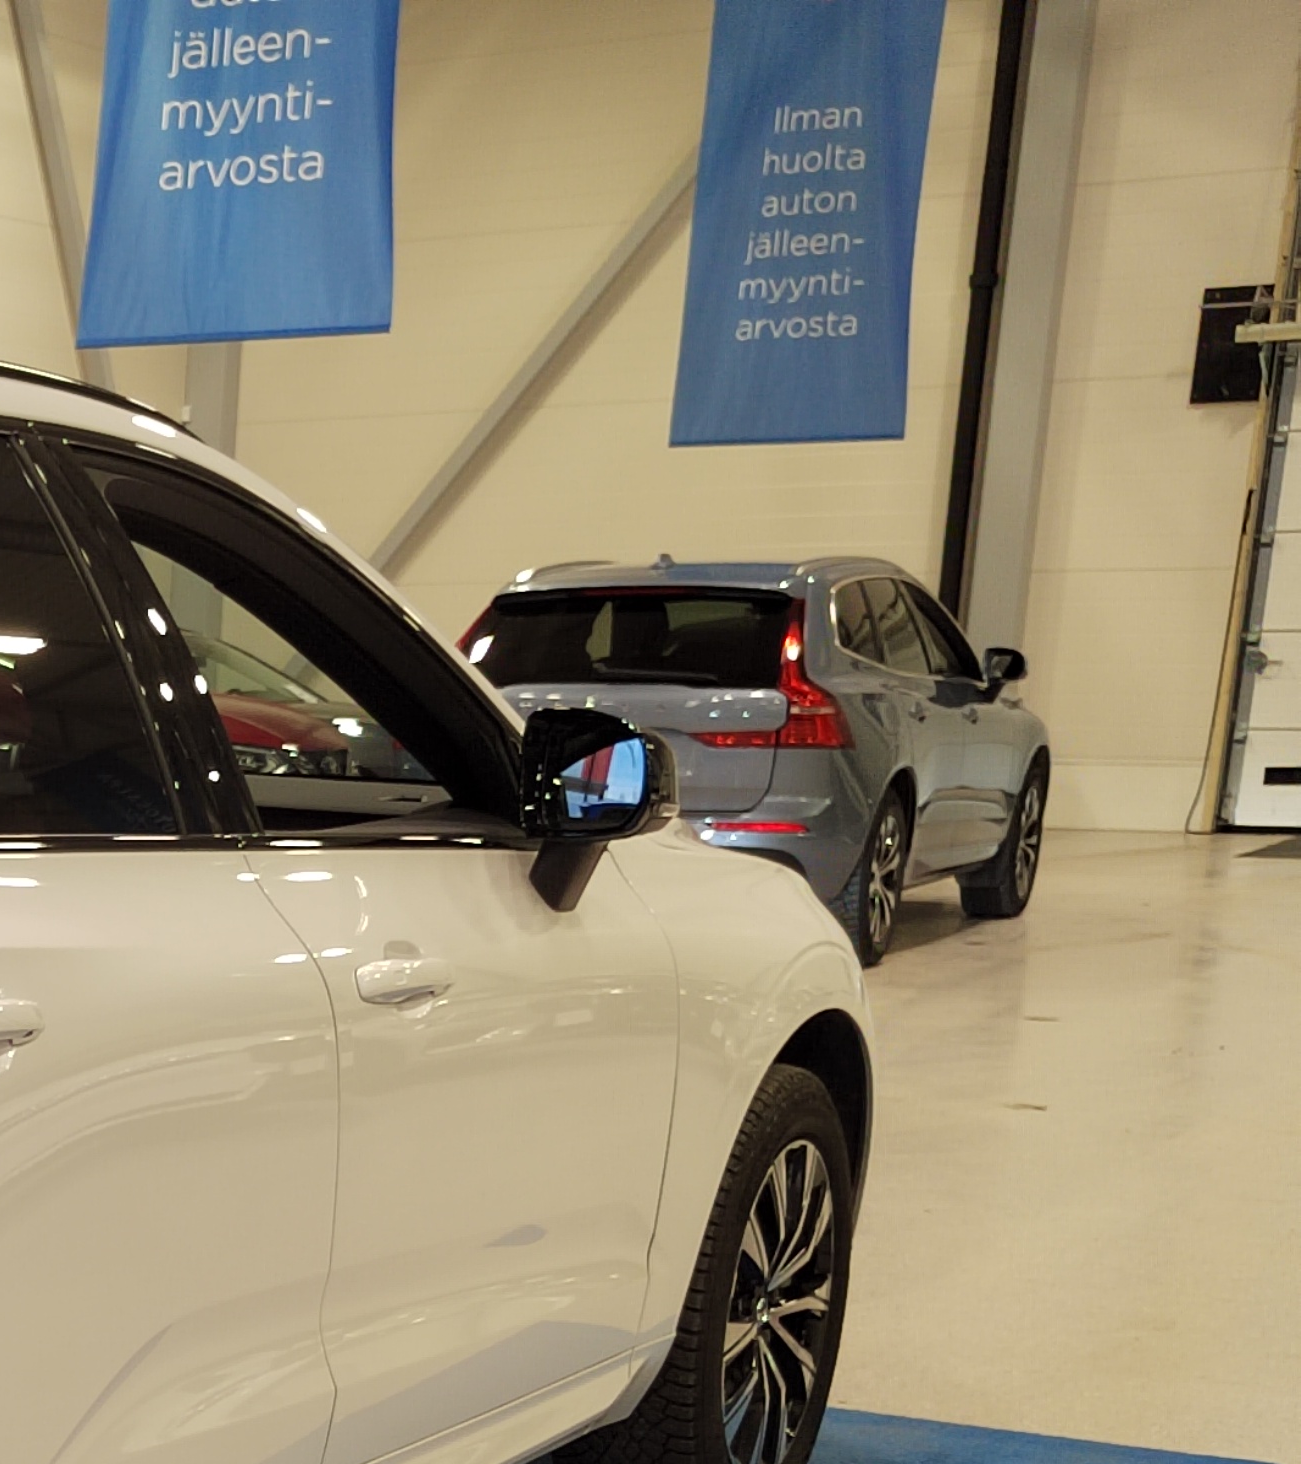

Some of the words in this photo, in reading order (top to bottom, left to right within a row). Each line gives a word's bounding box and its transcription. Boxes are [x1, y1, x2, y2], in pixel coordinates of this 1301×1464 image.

[167, 26, 332, 79] jälleen-
[160, 79, 334, 137] myynti-
[773, 104, 863, 135] Ilman
[158, 144, 325, 191] arvosta
[761, 143, 867, 177] huolta
[760, 187, 858, 218] auton
[743, 228, 866, 266] jälleen-
[737, 268, 866, 304] myynti-
[734, 310, 859, 342] arvosta
